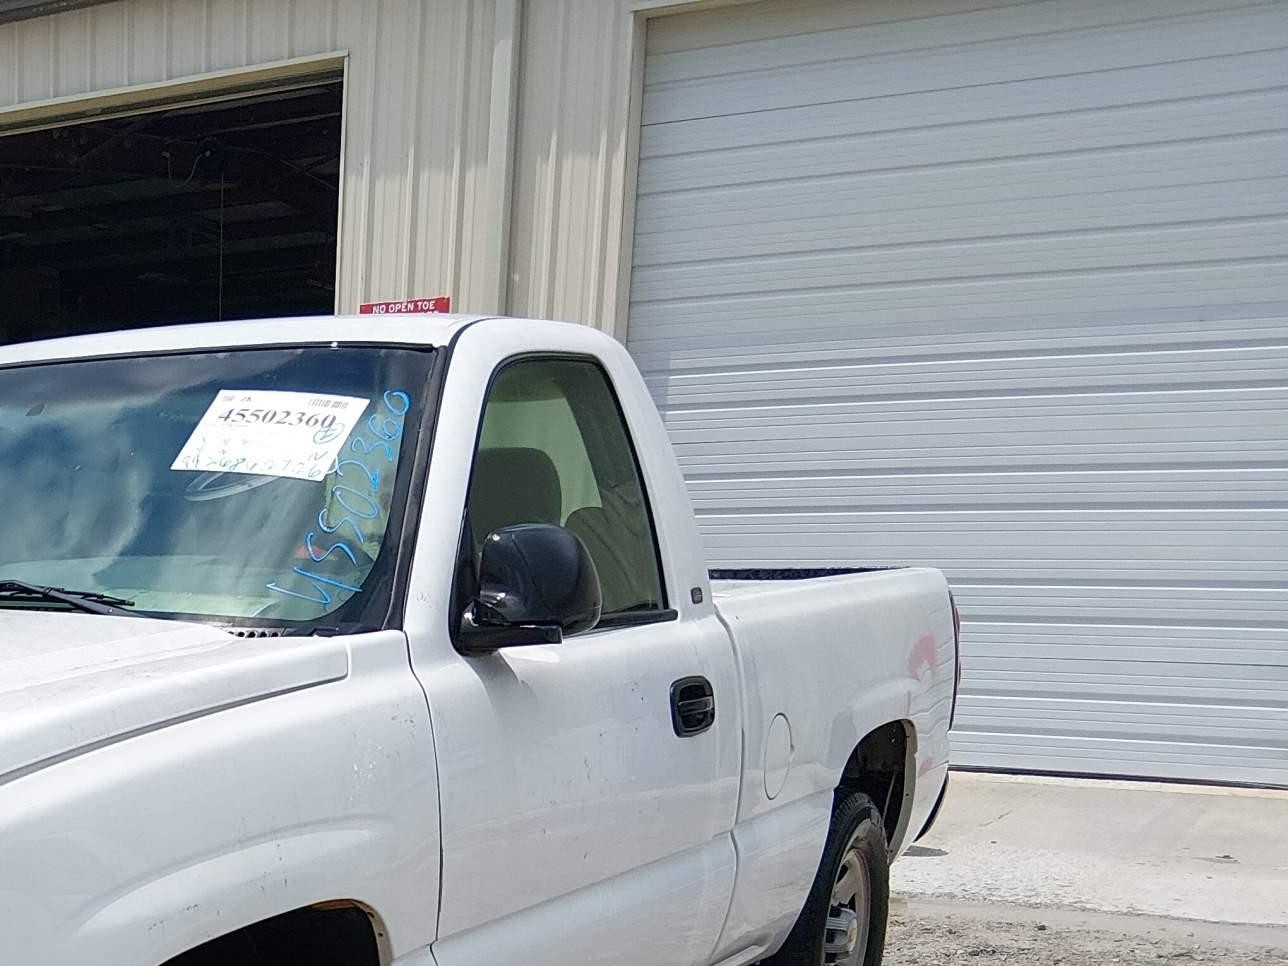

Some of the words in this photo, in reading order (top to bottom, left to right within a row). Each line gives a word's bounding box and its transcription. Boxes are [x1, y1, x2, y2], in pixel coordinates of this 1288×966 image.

[372, 304, 386, 314] NO
[388, 303, 415, 313] OPEN
[417, 300, 436, 310] TOE
[218, 408, 337, 428] 45502360
[266, 390, 410, 604] 45502360
